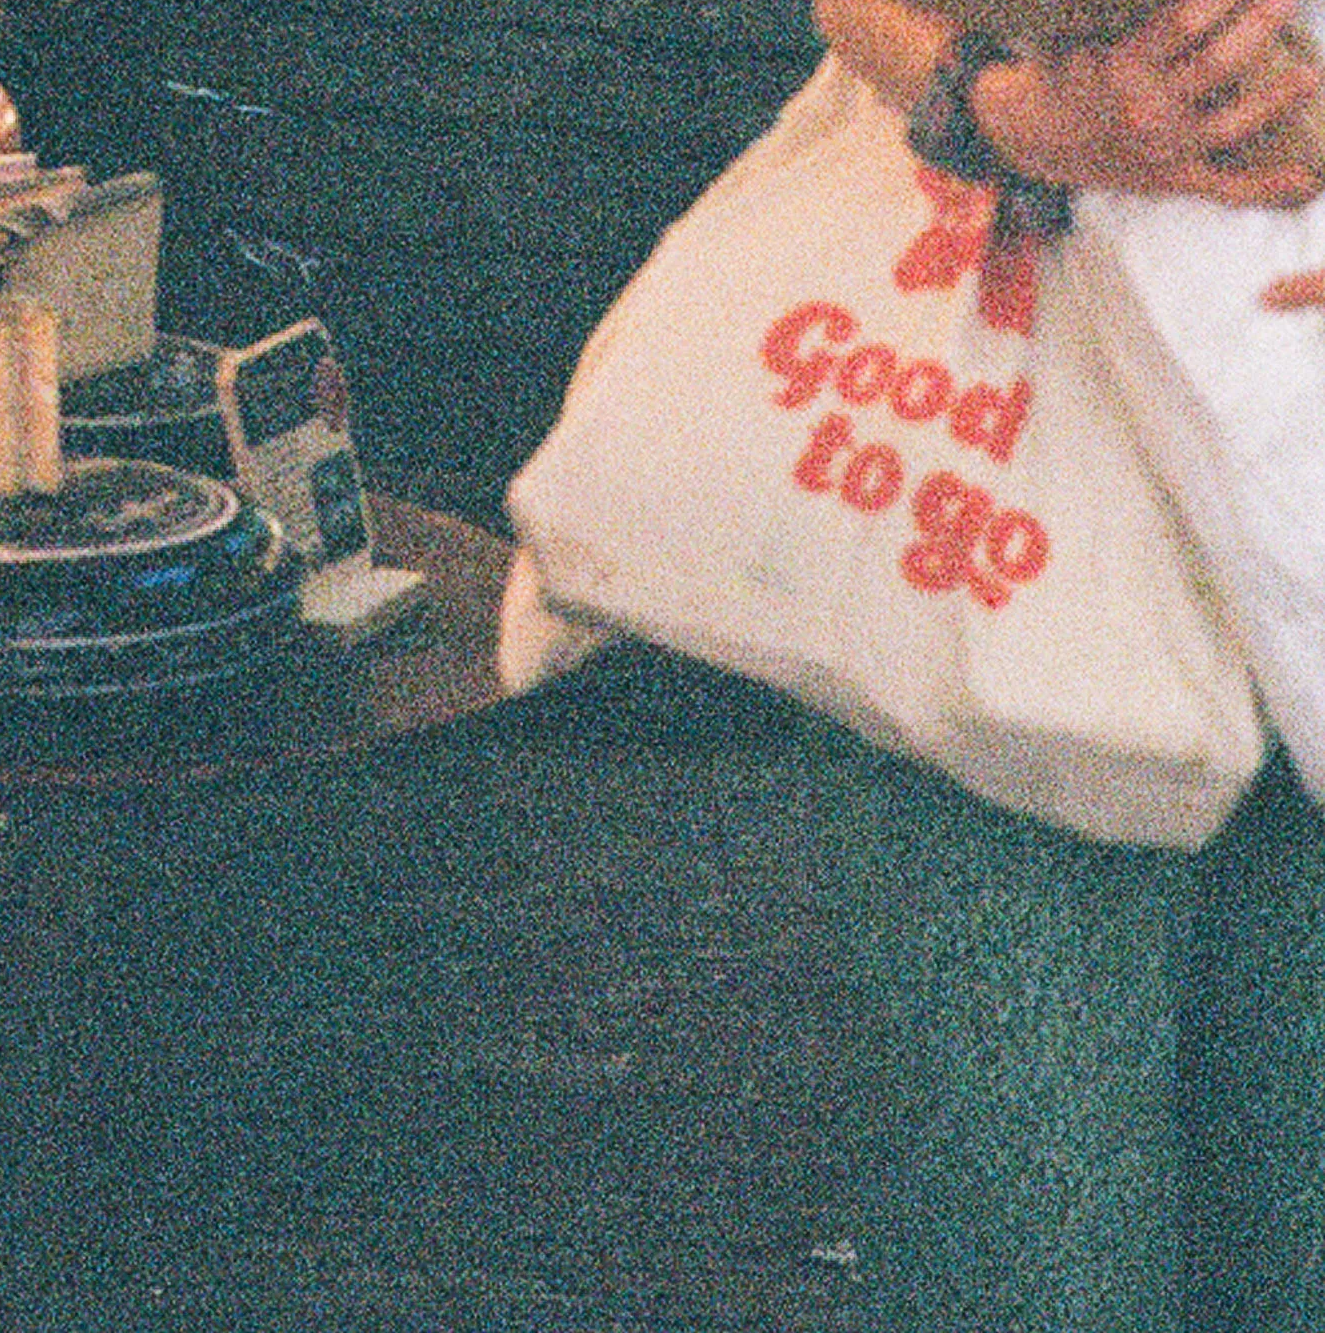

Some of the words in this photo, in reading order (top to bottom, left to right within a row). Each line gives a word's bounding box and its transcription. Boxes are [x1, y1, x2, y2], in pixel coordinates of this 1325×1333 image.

[759, 300, 1033, 464] Good
[793, 412, 905, 514] to
[899, 471, 1050, 611] go
